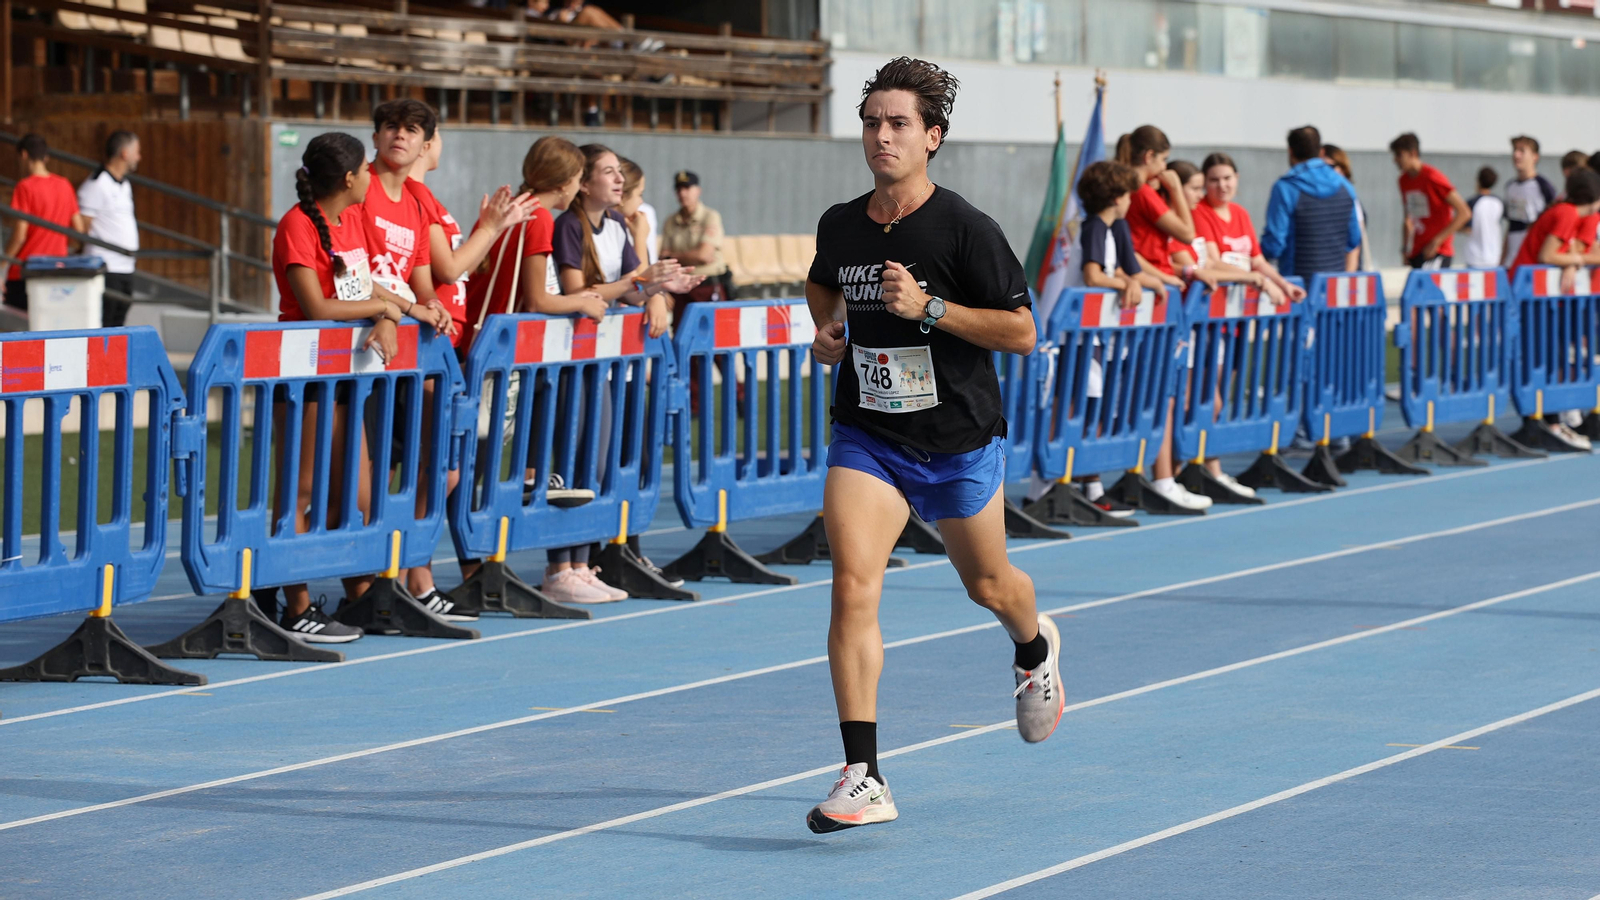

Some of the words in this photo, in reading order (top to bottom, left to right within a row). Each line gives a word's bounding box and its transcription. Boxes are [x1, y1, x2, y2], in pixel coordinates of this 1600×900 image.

[838, 264, 883, 284] NIKE
[339, 278, 362, 300] 1362
[860, 363, 893, 390] 748
